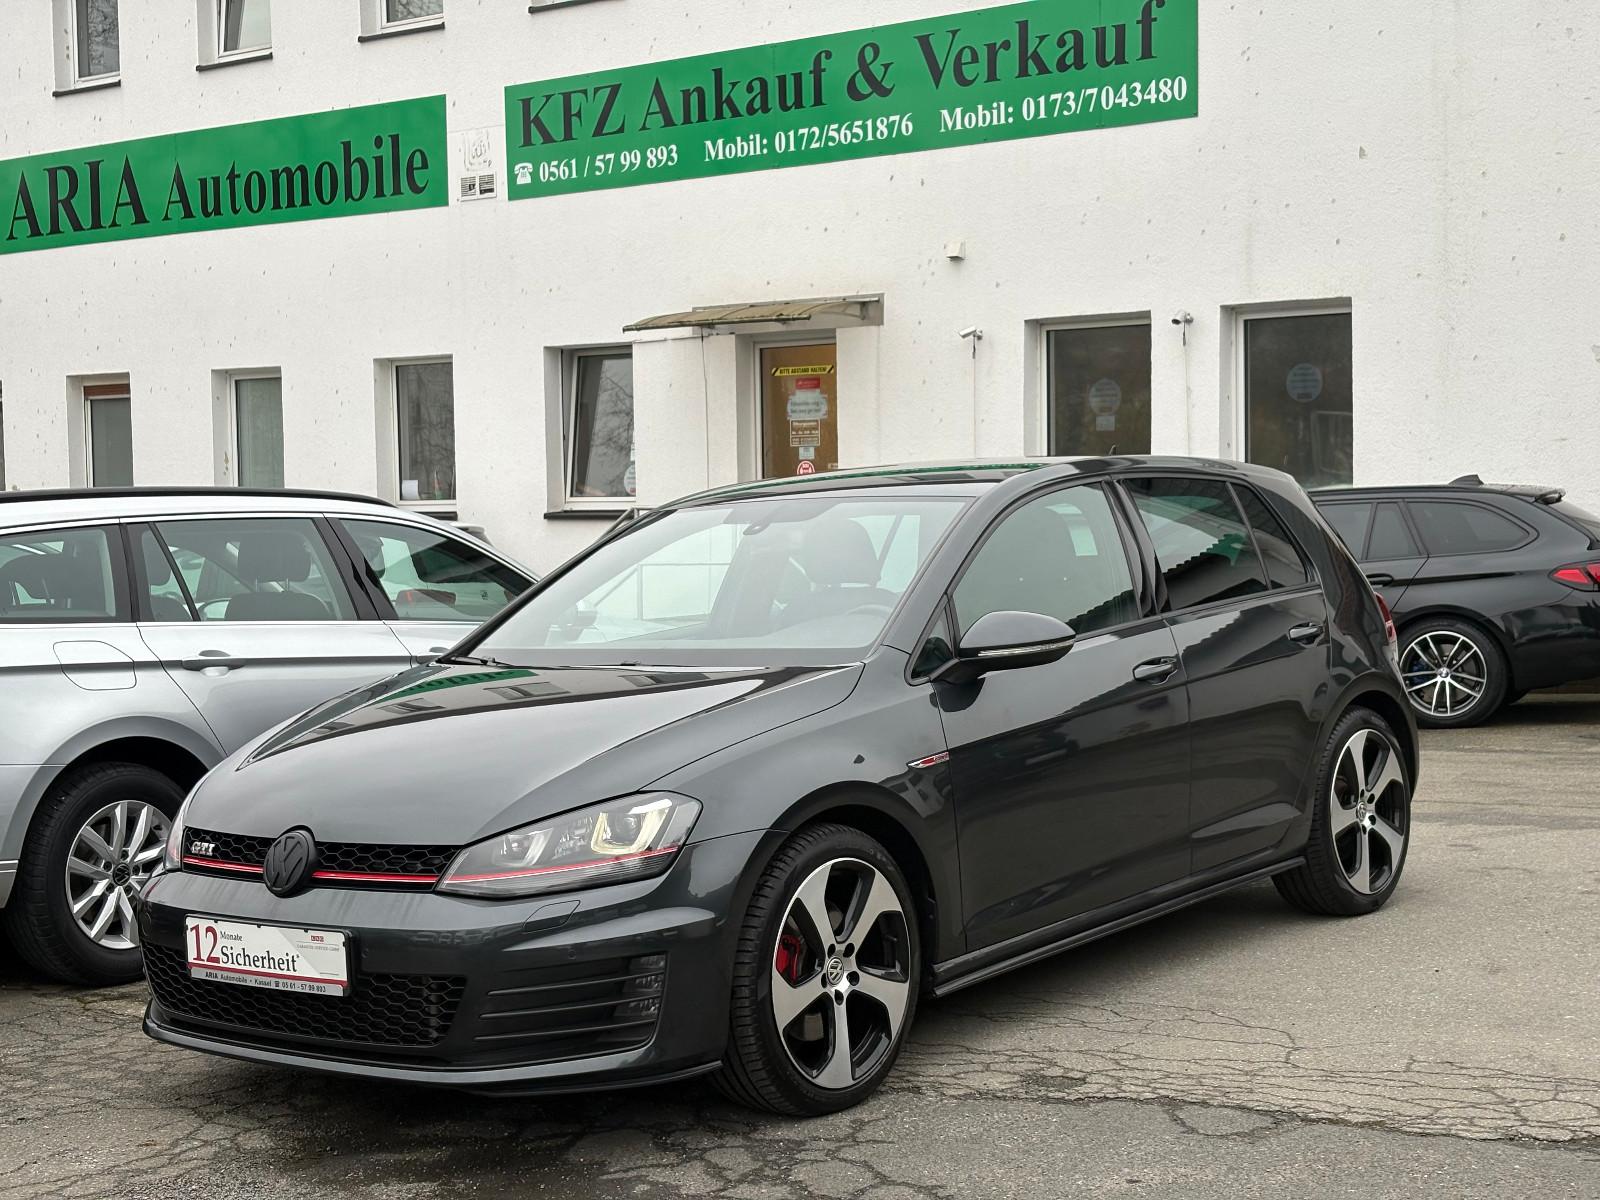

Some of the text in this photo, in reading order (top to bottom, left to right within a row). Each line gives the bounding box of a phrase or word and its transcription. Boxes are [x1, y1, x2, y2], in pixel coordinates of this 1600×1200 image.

[518, 0, 1167, 148] KFZ Ankauf & Verkauf
[539, 159, 578, 183] 0561
[594, 154, 615, 176] 57
[620, 150, 641, 173] 99
[646, 144, 679, 169] 893
[704, 133, 769, 162] Mobil:
[774, 112, 914, 154] 0172/5651876
[939, 102, 1015, 133] Mobil:
[1022, 76, 1187, 121] 0173/7043480
[5, 153, 148, 241] ARIA
[161, 134, 430, 222] Automobile
[191, 841, 216, 857] GTI
[189, 923, 221, 965] 12
[219, 930, 243, 942] Monate
[205, 971, 219, 980] ARIA
